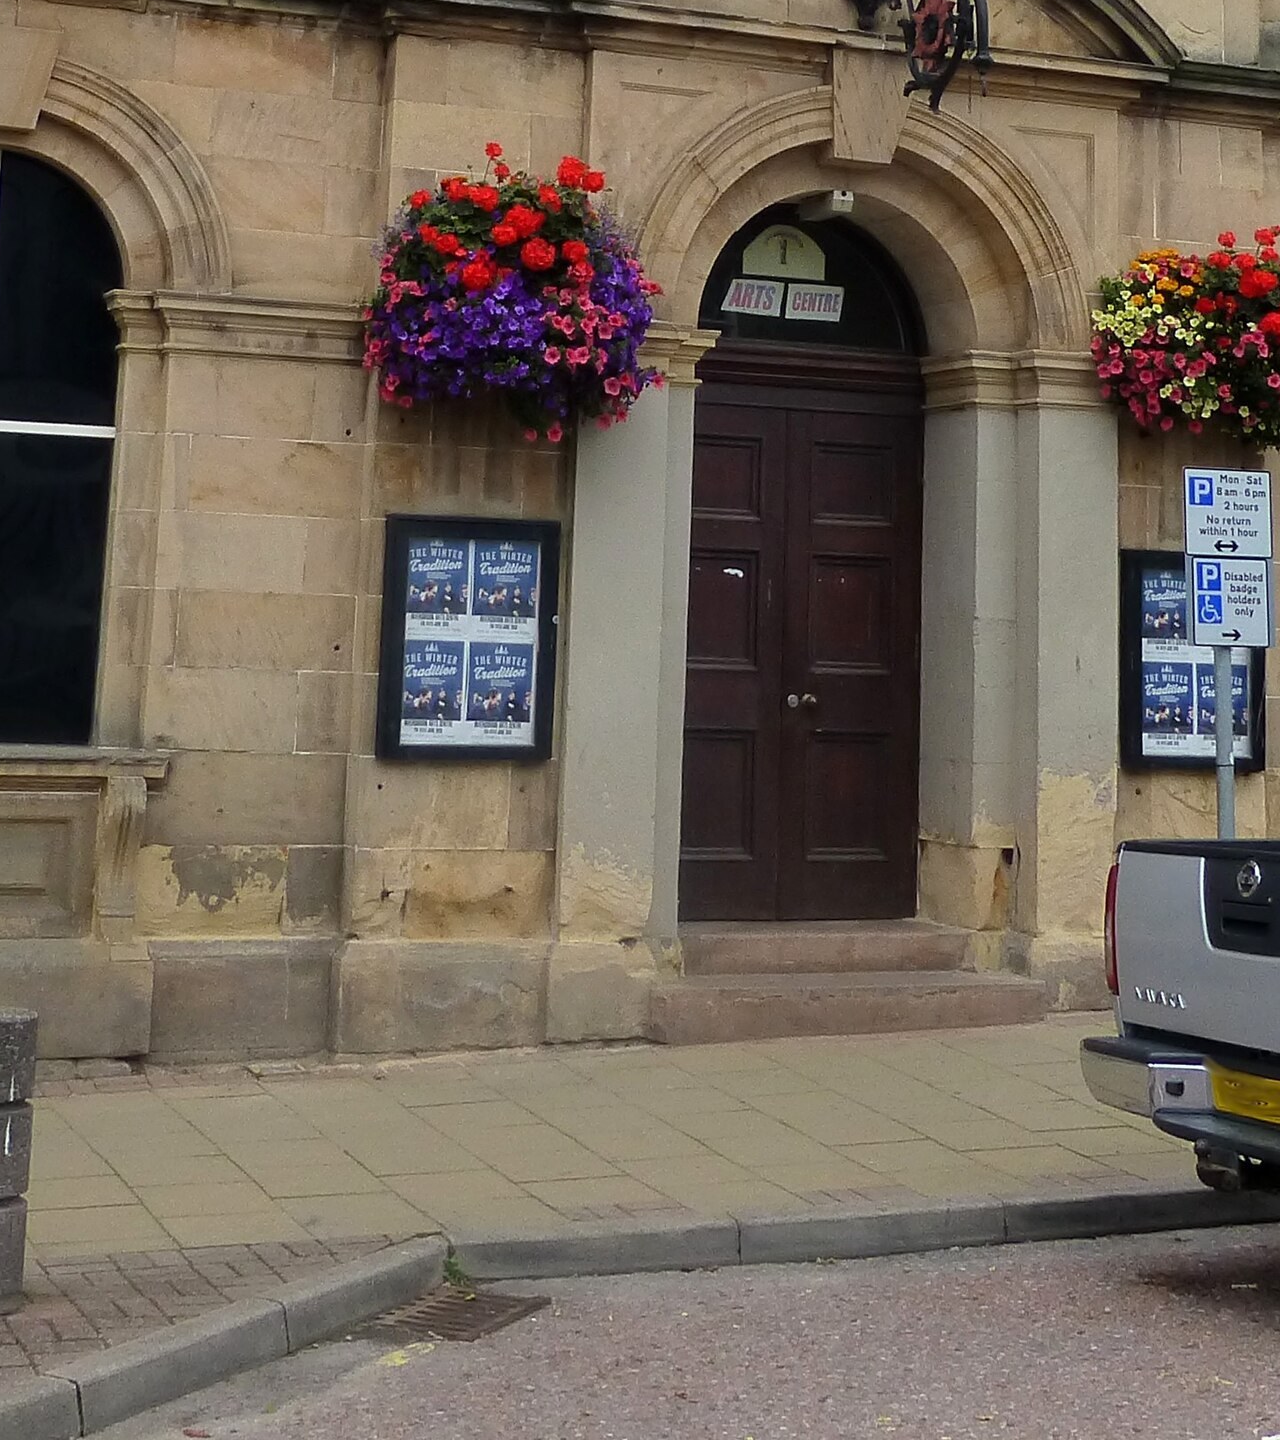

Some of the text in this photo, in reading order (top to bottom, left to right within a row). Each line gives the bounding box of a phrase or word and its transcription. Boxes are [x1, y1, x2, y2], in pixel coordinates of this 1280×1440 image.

[728, 282, 840, 312] ARTS CENTRE
[1220, 475, 1239, 484] Mon
[1246, 476, 1262, 485] Sat
[1194, 479, 1210, 503] P
[1224, 501, 1259, 511] 2 hours
[1207, 515, 1251, 526] No return
[1200, 527, 1228, 536] within
[1237, 528, 1259, 537] hour
[431, 547, 464, 560] WINTER
[500, 551, 532, 563] WINTER
[410, 558, 462, 572] Tradition
[480, 562, 532, 575] Tradition
[1202, 564, 1218, 589] P
[1224, 572, 1263, 582] Disabled
[1230, 583, 1257, 594] badge
[1227, 595, 1261, 605] holders
[1235, 607, 1254, 618] only
[425, 653, 458, 665] WINTER
[495, 655, 527, 667] WINTER
[404, 663, 457, 677] Tradition
[474, 666, 526, 680] Tradition
